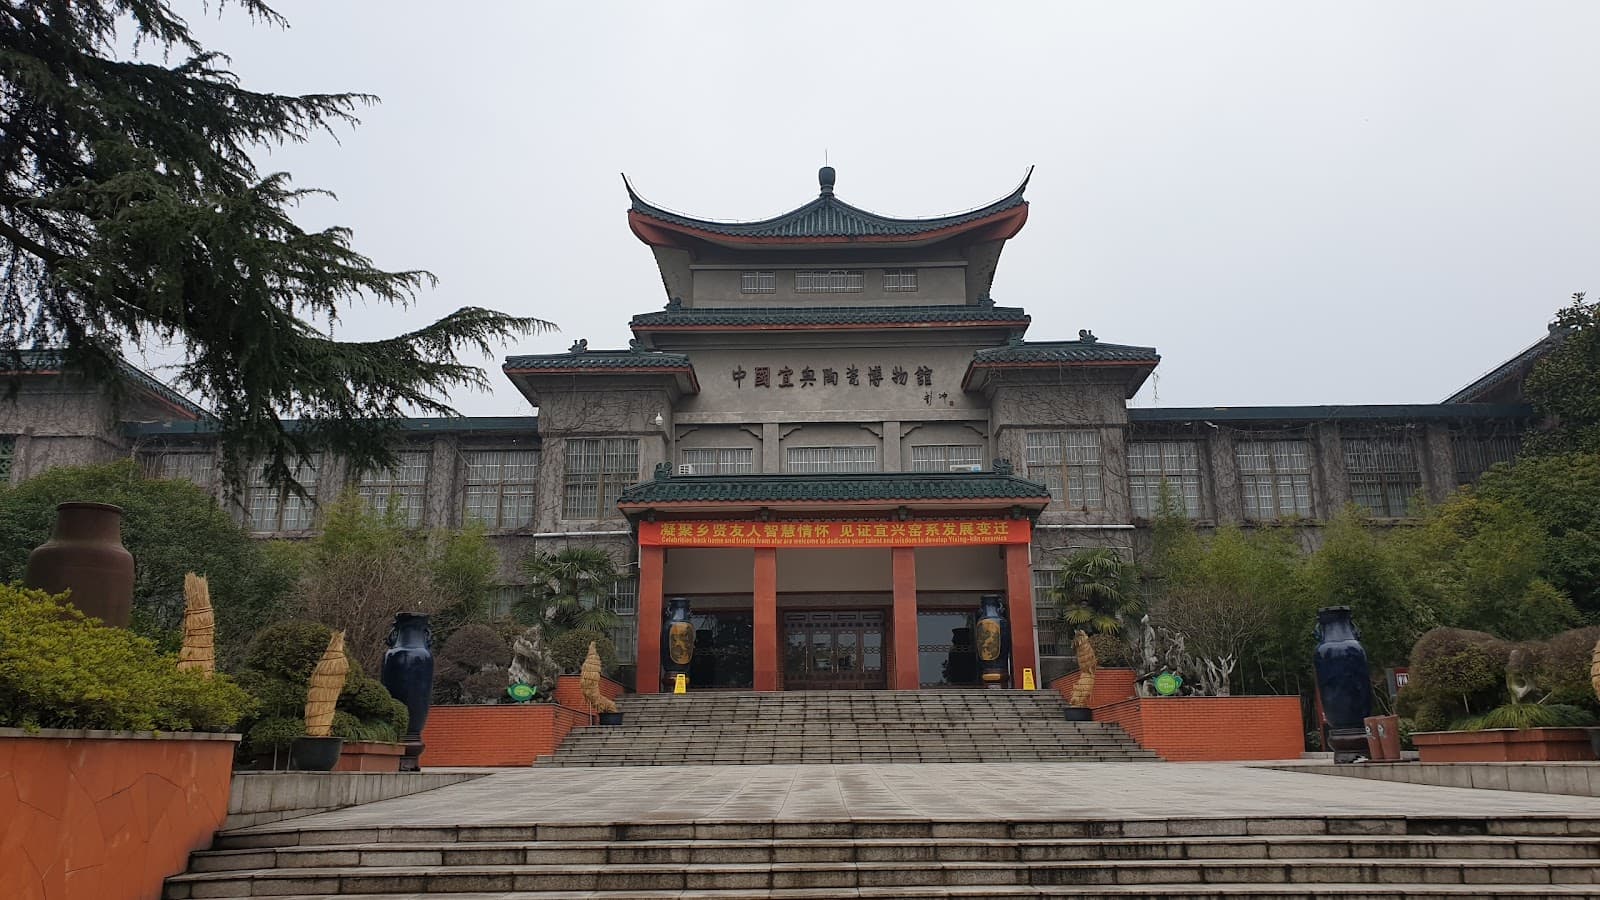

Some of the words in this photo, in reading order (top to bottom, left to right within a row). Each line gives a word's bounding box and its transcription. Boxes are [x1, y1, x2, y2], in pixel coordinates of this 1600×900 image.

[661, 523, 829, 537] 凝聚乡贤友人智慧情怀
[840, 522, 1008, 537] 见证宜兴窑系发展变迁
[661, 536, 691, 544] Celebrities
[693, 536, 706, 545] back
[707, 536, 724, 545] home
[726, 537, 736, 545] and
[736, 537, 757, 545] friends
[757, 537, 771, 545] from
[793, 537, 819, 545] welcome
[826, 537, 850, 545] dedicate
[851, 537, 865, 546] your
[866, 536, 882, 544] talent
[883, 536, 892, 544] and
[892, 536, 918, 545] wisdom
[924, 535, 947, 545] develop
[980, 534, 1007, 543] ceramics
